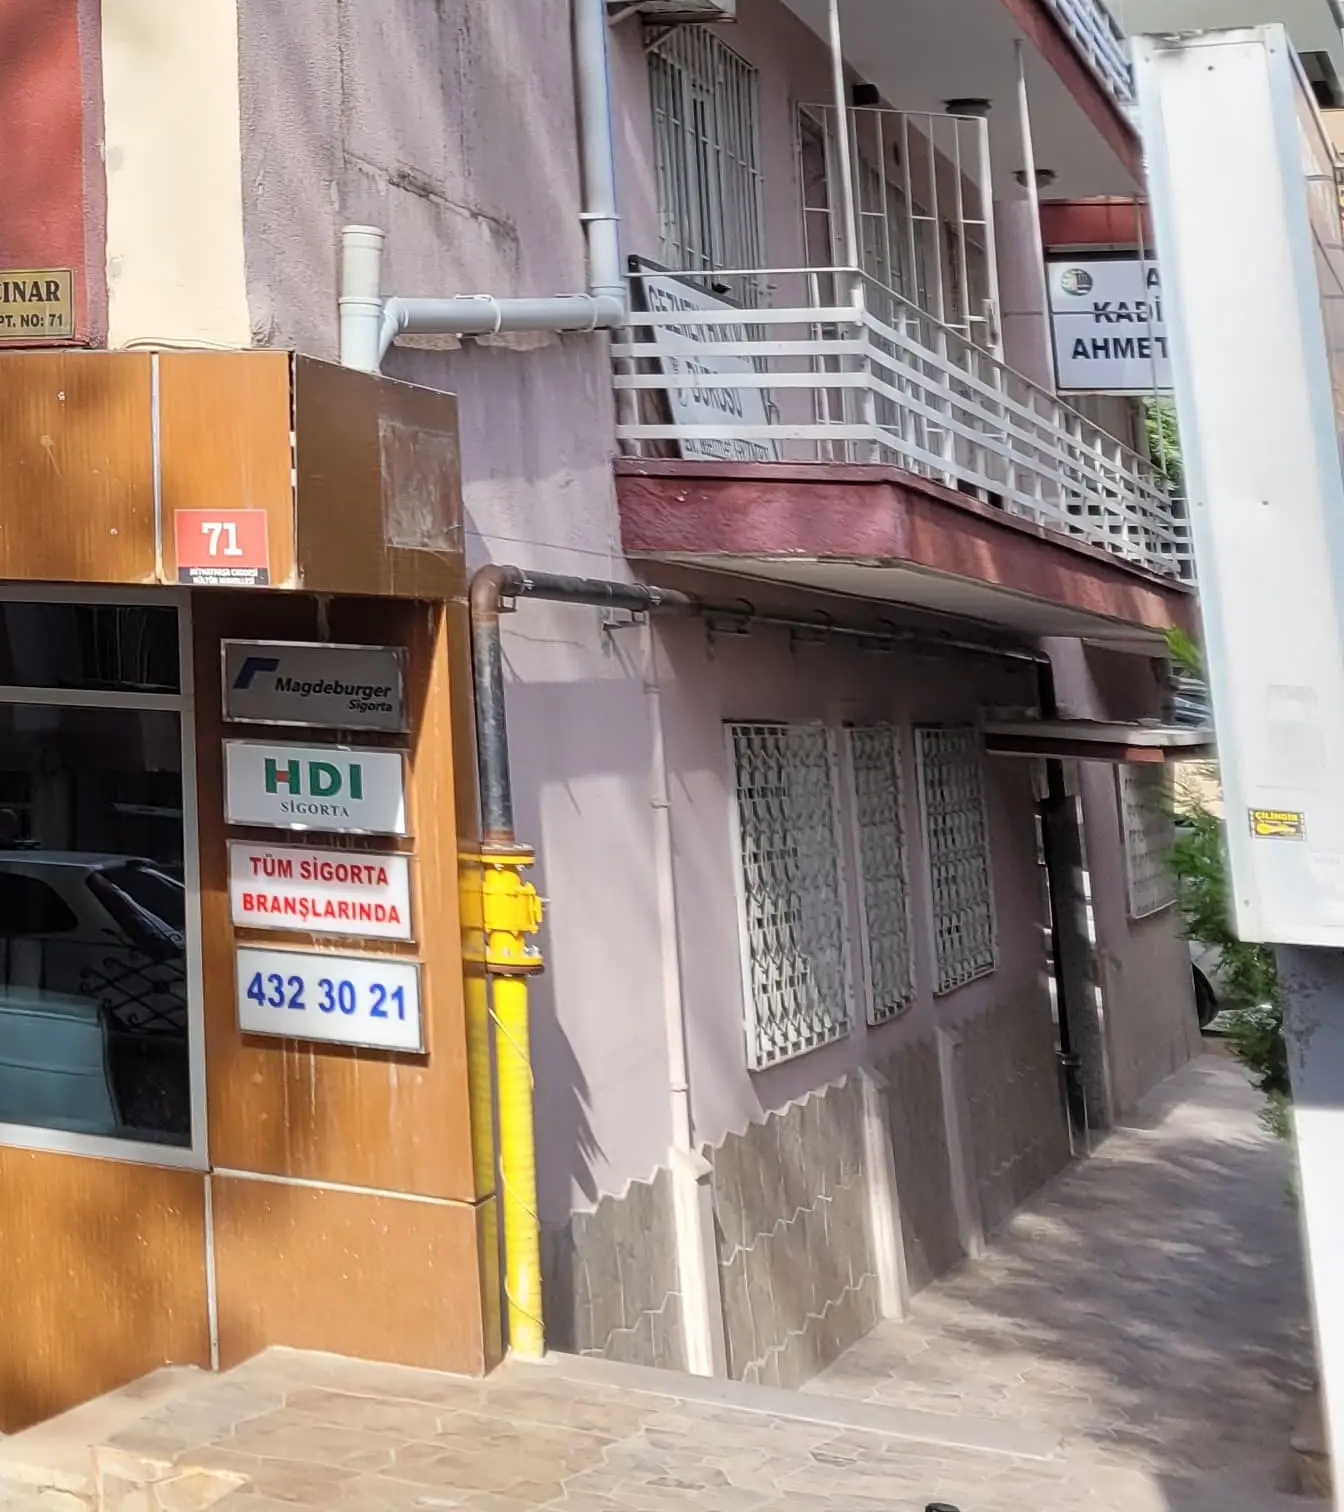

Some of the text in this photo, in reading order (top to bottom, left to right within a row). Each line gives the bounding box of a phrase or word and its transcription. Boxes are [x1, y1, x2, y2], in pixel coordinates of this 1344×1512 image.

[20, 314, 44, 328] NO:
[49, 313, 63, 326] 71
[1072, 336, 1168, 360] AHMET
[200, 521, 244, 557] 71
[274, 677, 393, 701] Magdeburger
[348, 699, 393, 714] Sigorta
[264, 757, 363, 801] HDI
[280, 799, 350, 817] SİGORTA
[249, 853, 389, 886] TÜM SİGORTA
[242, 892, 401, 925] BRANŞLARINDA
[247, 971, 406, 1021] 432 30 21
